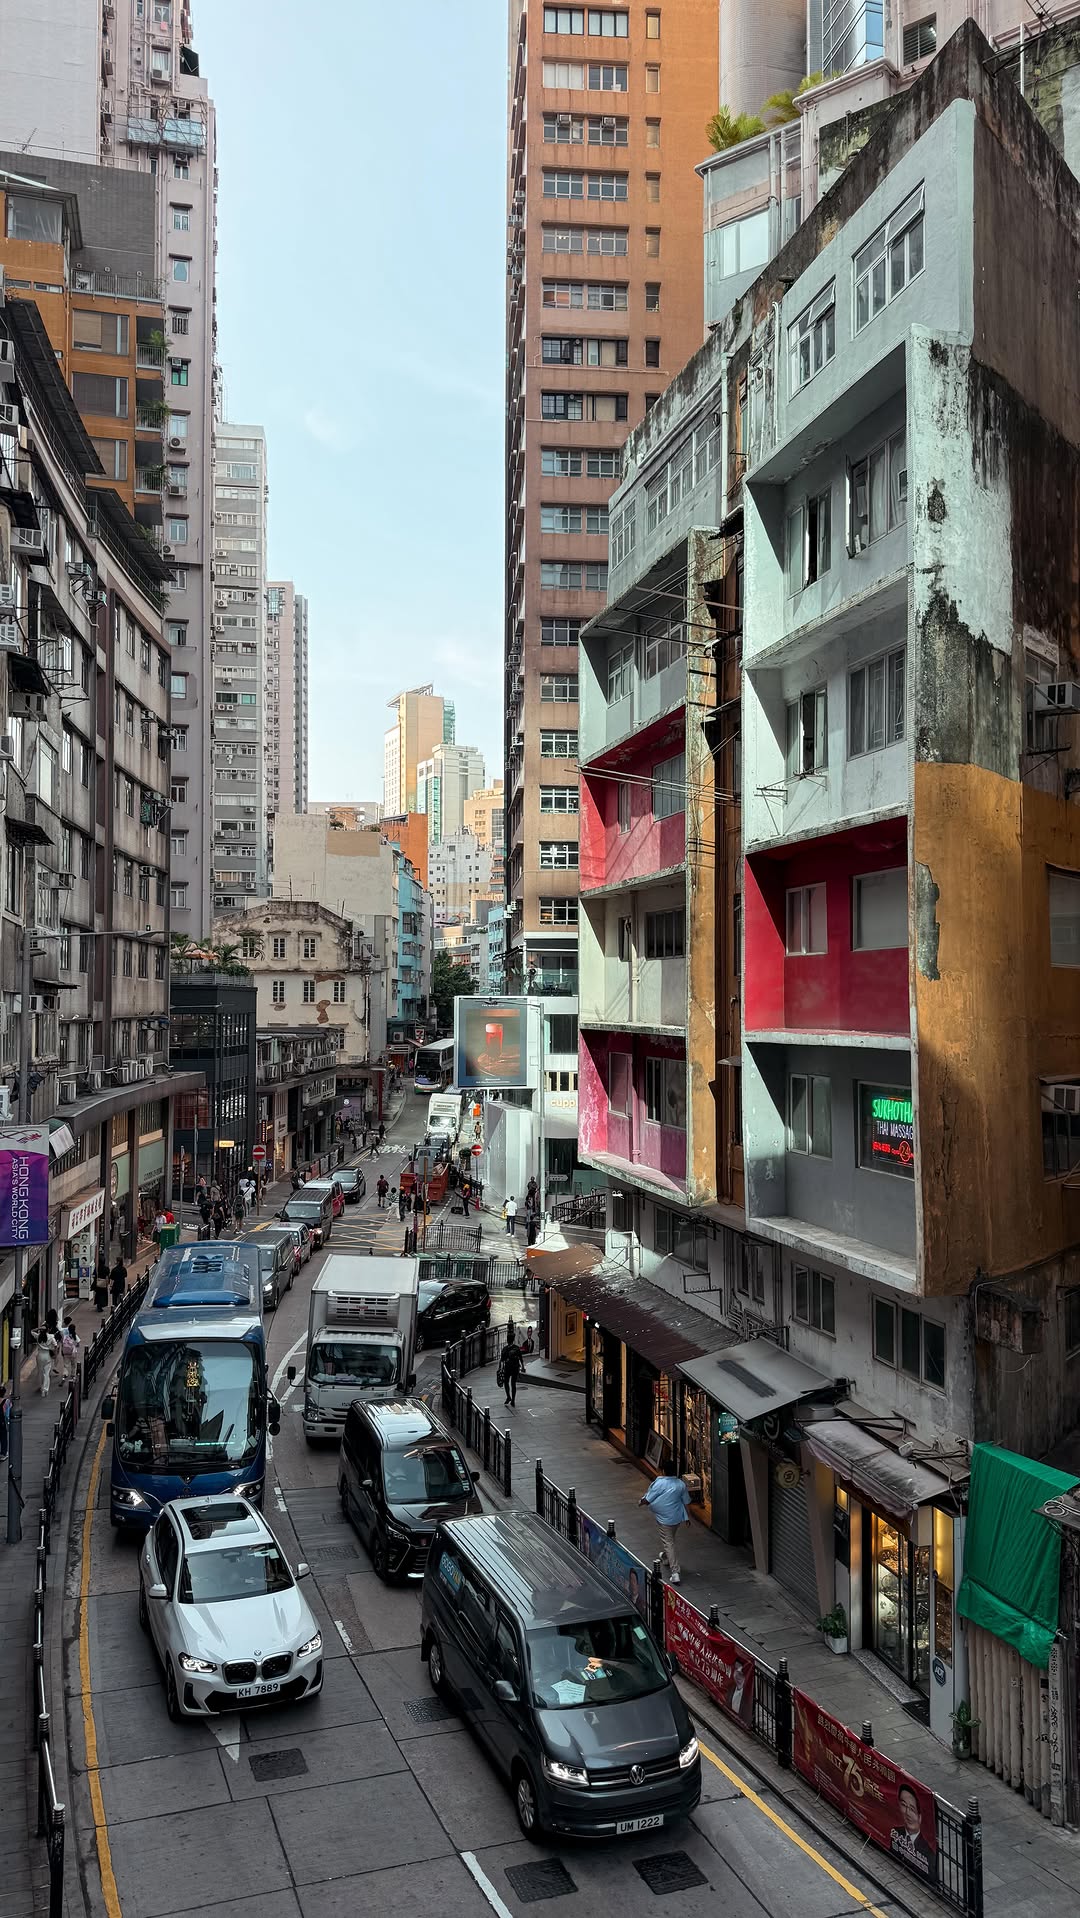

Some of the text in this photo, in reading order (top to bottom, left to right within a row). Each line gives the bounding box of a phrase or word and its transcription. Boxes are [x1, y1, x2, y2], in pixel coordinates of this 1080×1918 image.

[877, 1121, 889, 1136] THAI
[11, 1157, 19, 1239] ASIA'S WORLD CITY
[18, 1156, 29, 1239] HONG KONG
[238, 1683, 279, 1697] KH 7889
[620, 1816, 660, 1832] UM 1222
